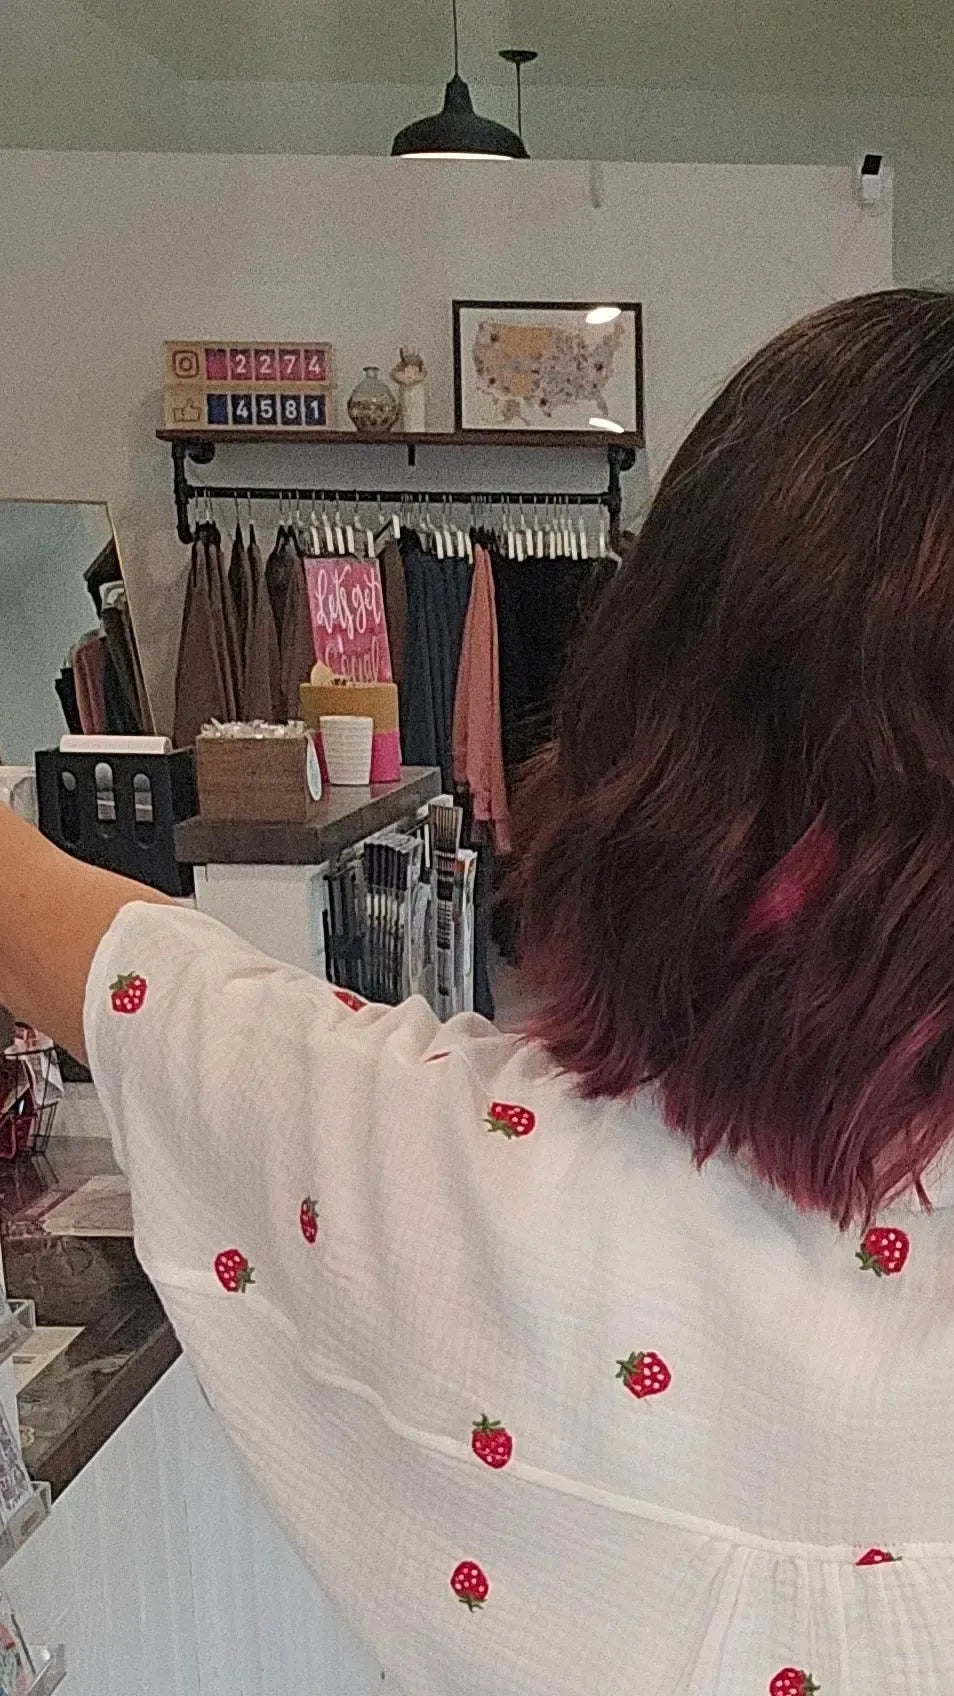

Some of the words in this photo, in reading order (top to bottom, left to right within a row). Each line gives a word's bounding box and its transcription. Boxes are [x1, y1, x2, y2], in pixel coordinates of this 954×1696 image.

[235, 354, 321, 374] 2274
[236, 400, 320, 419] 4581
[351, 567, 381, 634] get
